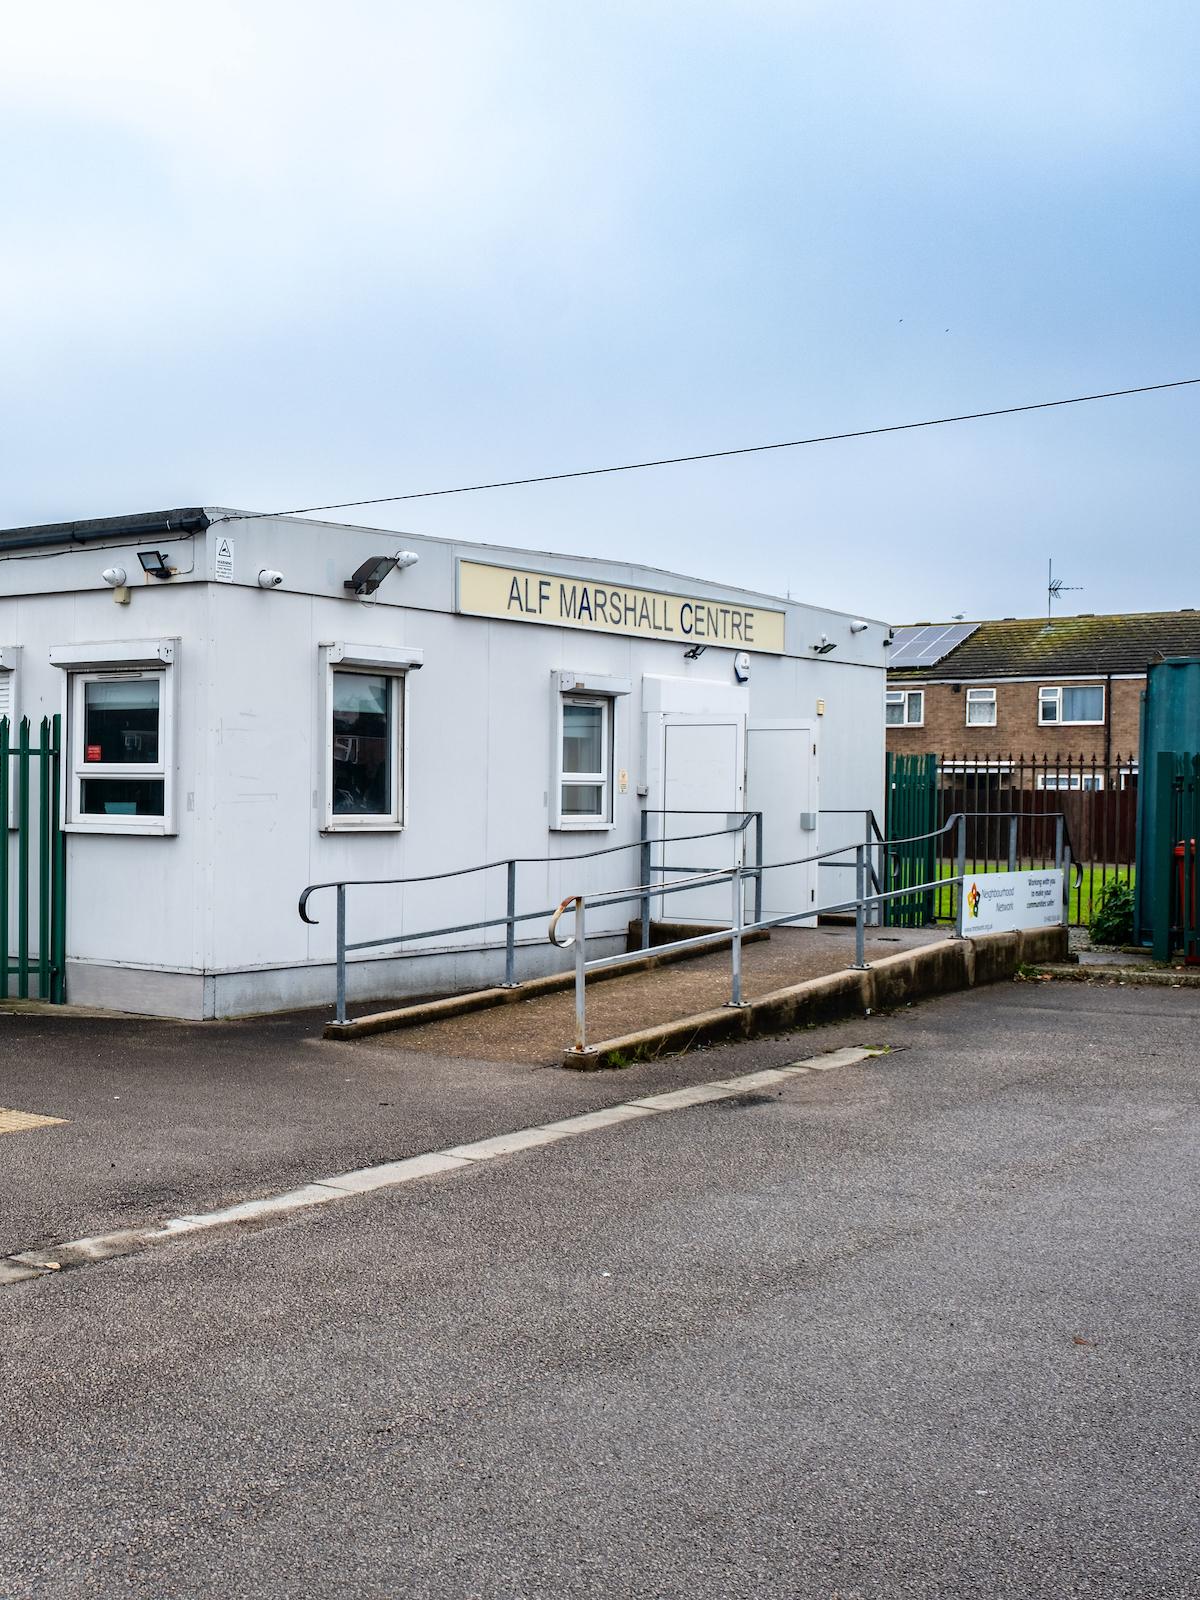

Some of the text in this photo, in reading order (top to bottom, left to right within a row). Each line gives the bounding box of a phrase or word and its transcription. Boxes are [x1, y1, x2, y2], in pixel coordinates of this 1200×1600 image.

[507, 576, 754, 643] ALF MARSHALL CENTRE
[982, 888, 1014, 901] Neighbourhood
[996, 902, 1014, 912] Network
